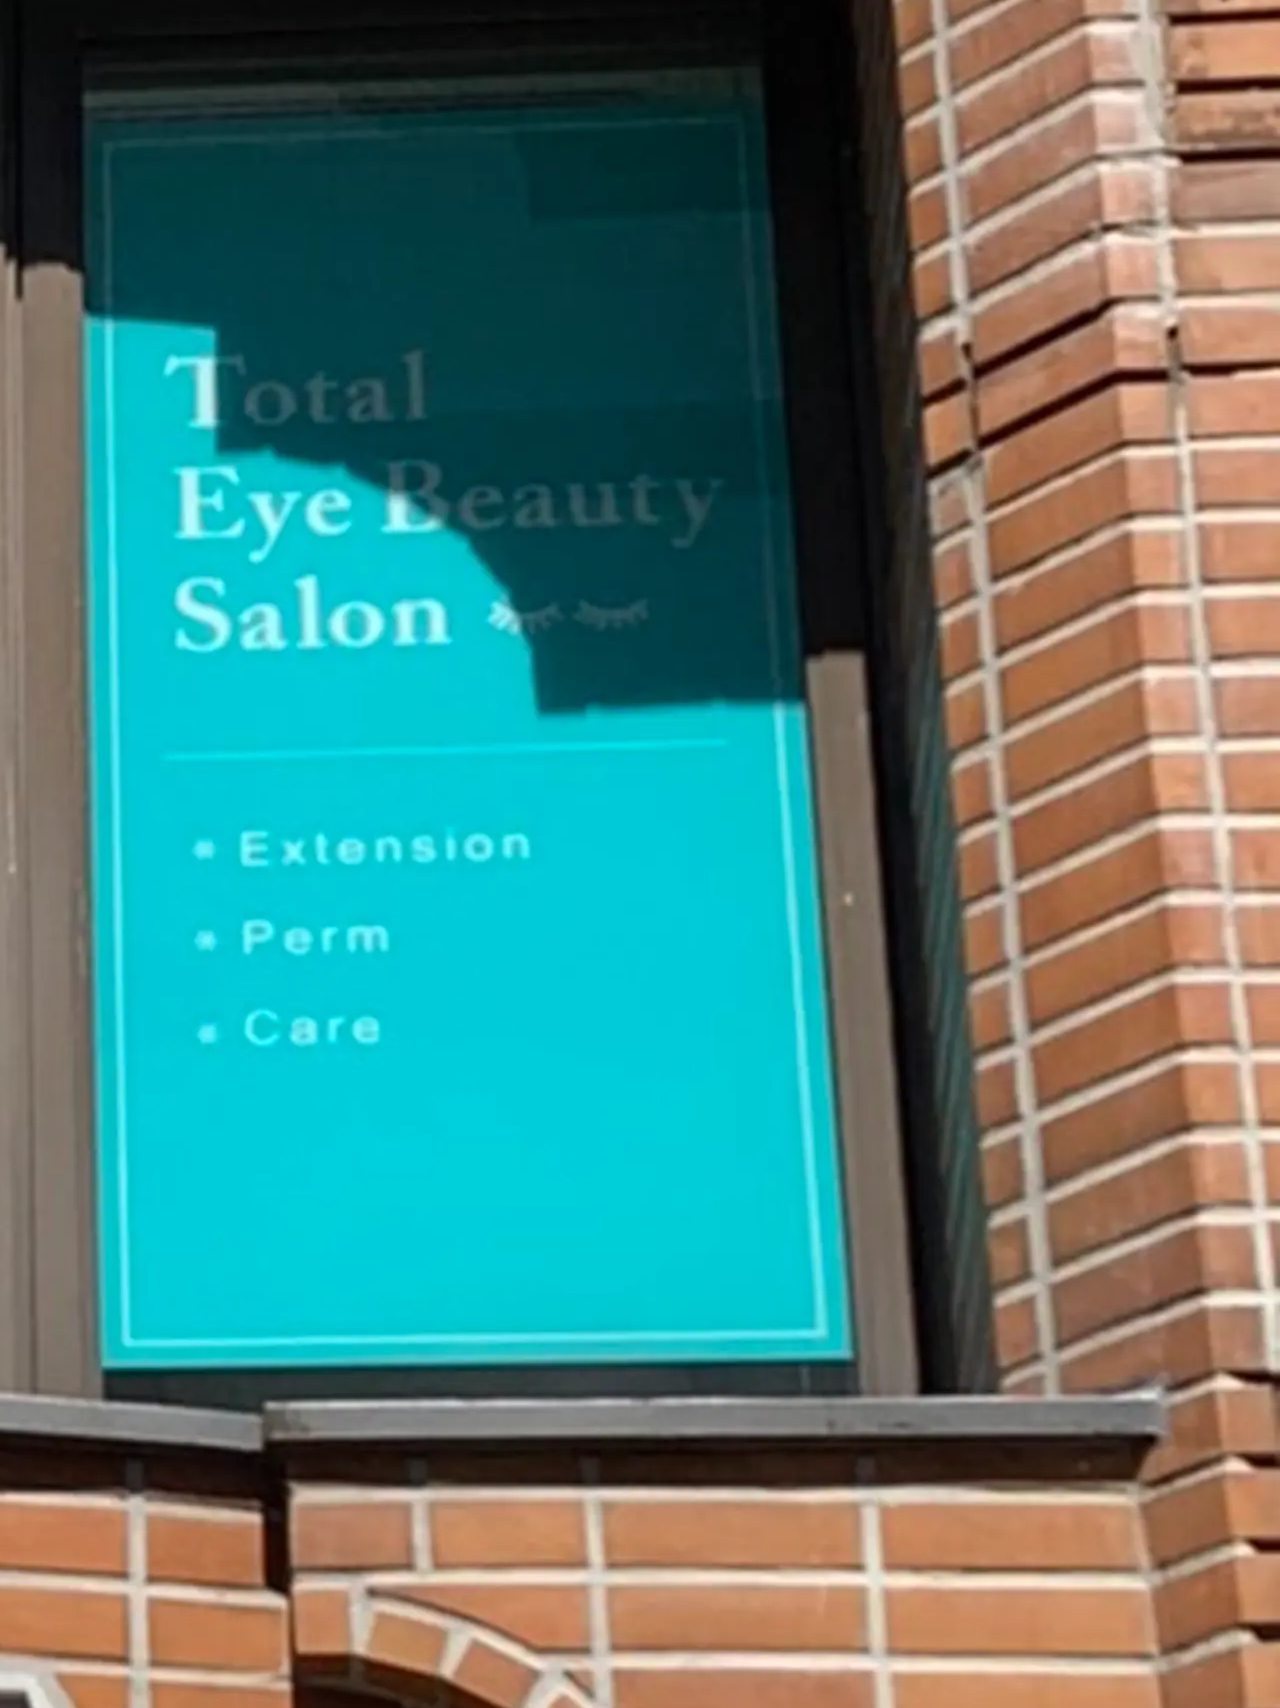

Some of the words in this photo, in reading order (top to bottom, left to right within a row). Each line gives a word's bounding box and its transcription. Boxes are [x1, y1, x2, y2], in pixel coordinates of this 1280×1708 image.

[163, 349, 429, 431] Total
[172, 465, 353, 563] Eye
[381, 458, 724, 549] Beauty
[172, 574, 452, 653] Salon
[239, 826, 532, 868] Extension
[241, 919, 390, 955] Perm
[243, 1010, 382, 1047] Care
